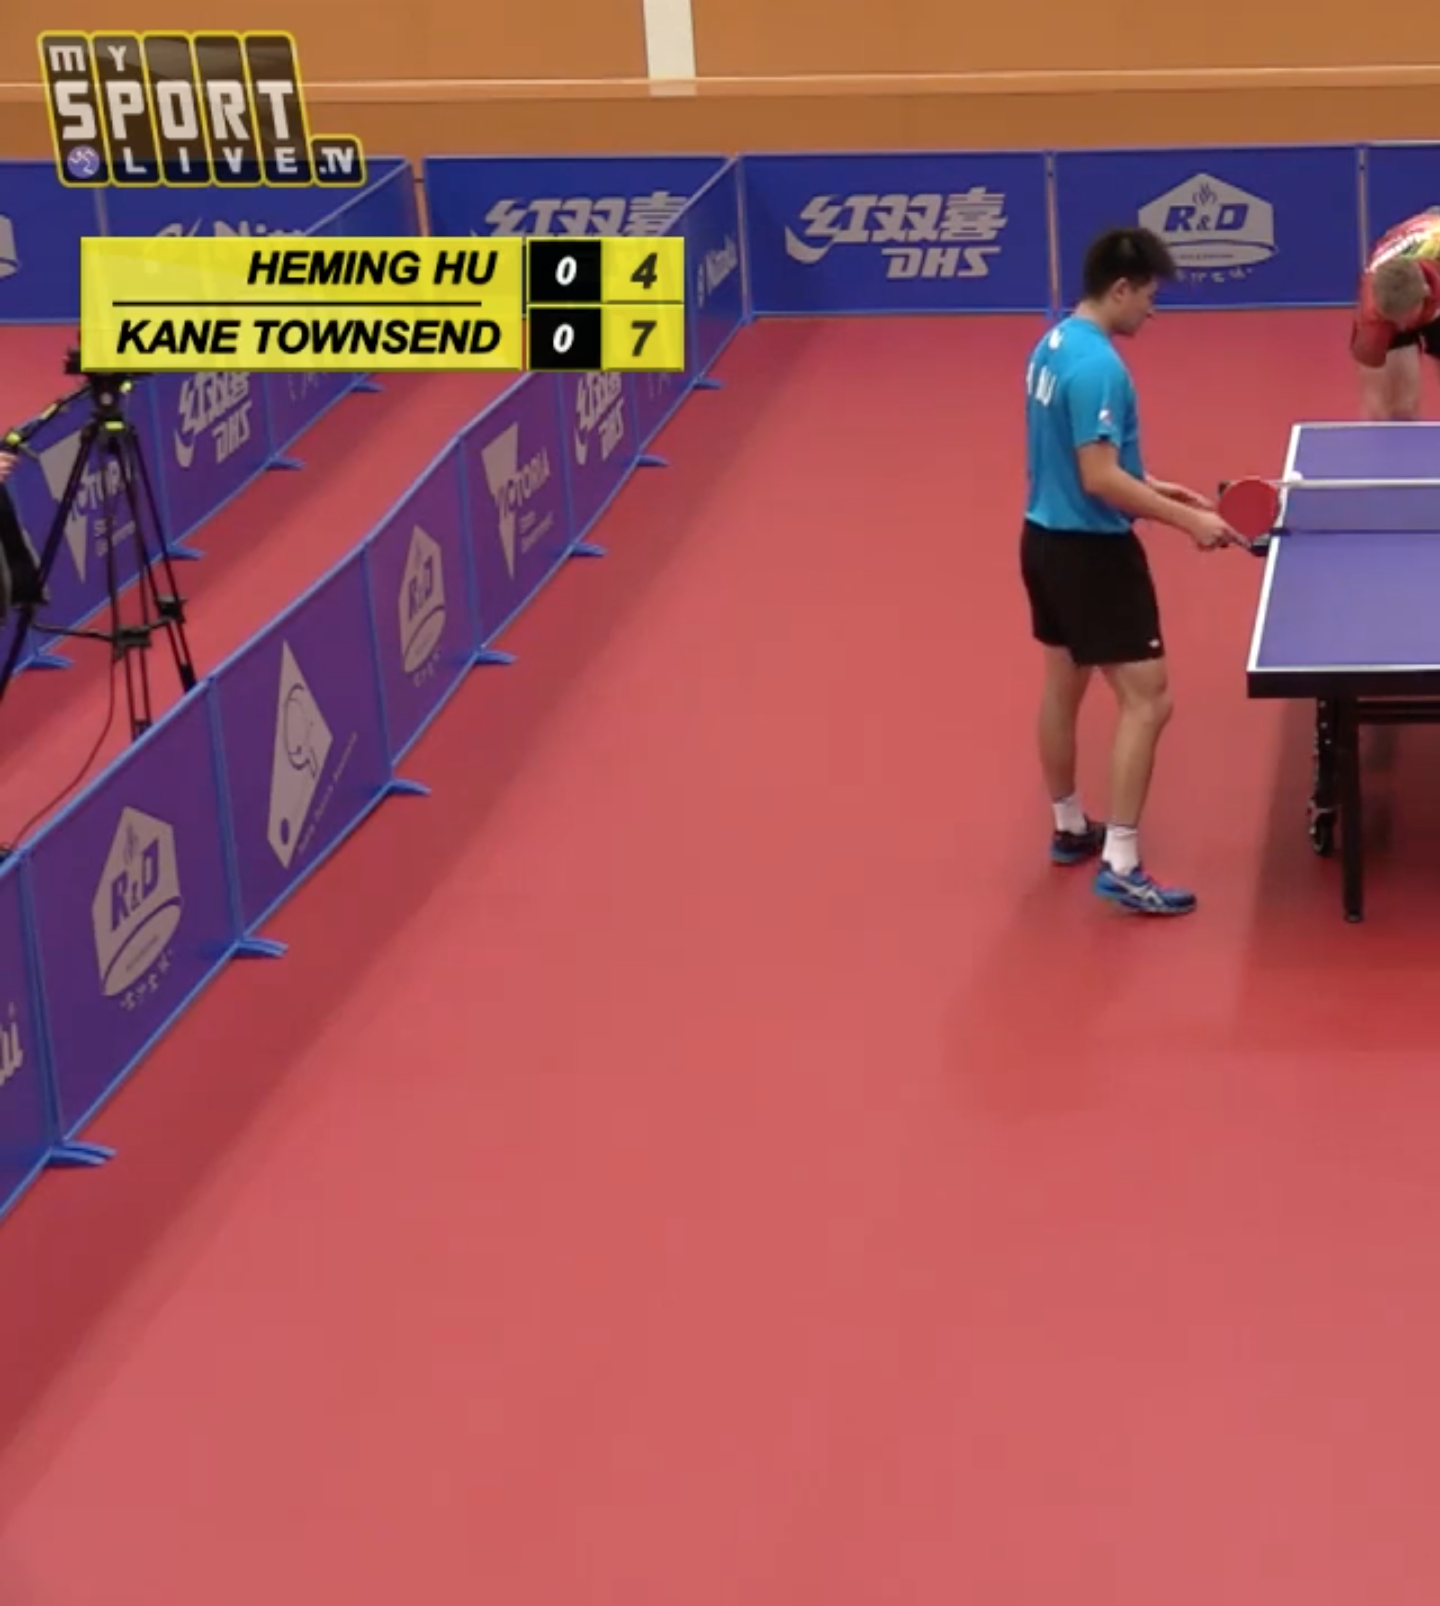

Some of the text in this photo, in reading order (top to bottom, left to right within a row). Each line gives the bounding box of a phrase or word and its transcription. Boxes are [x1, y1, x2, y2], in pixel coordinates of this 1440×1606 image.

[798, 186, 1008, 243] 红双喜
[881, 246, 1001, 279] DHS
